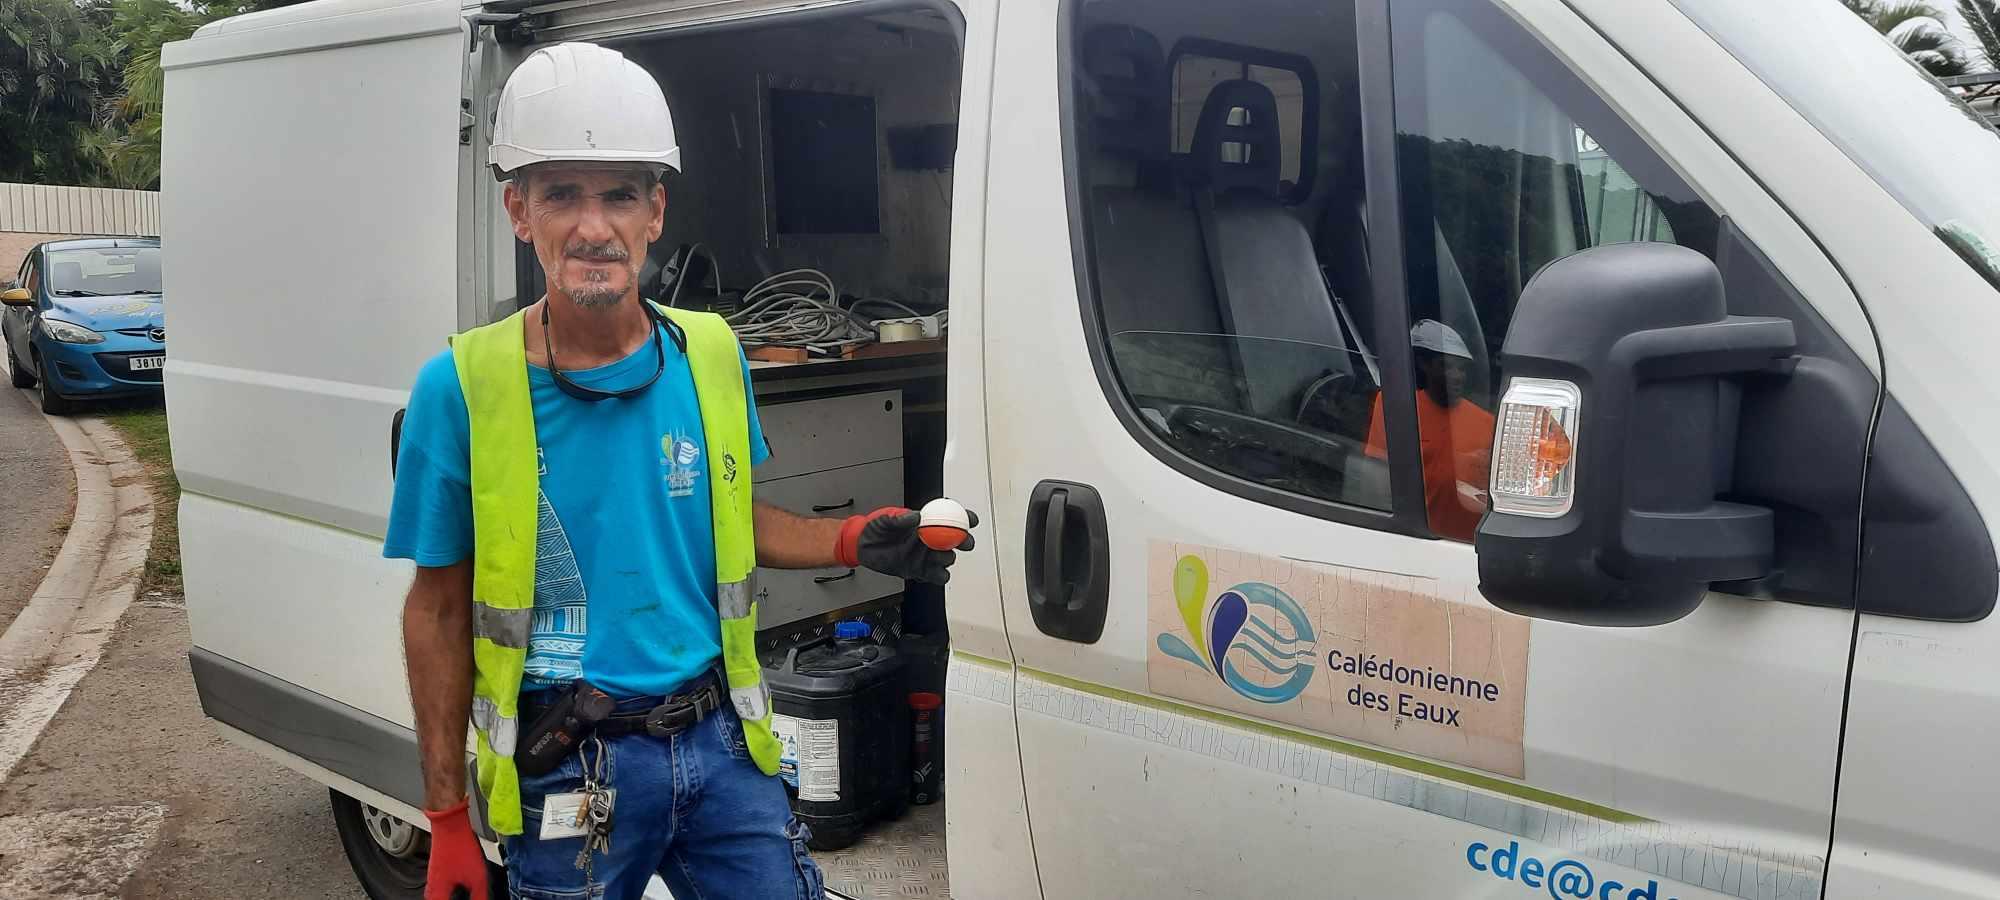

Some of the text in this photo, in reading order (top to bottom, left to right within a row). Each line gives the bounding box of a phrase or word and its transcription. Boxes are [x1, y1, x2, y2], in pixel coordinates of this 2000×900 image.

[1327, 650, 1499, 701] Calédonienne
[1347, 684, 1460, 728] des Eaux
[1466, 840, 1680, 900] cde@cd
